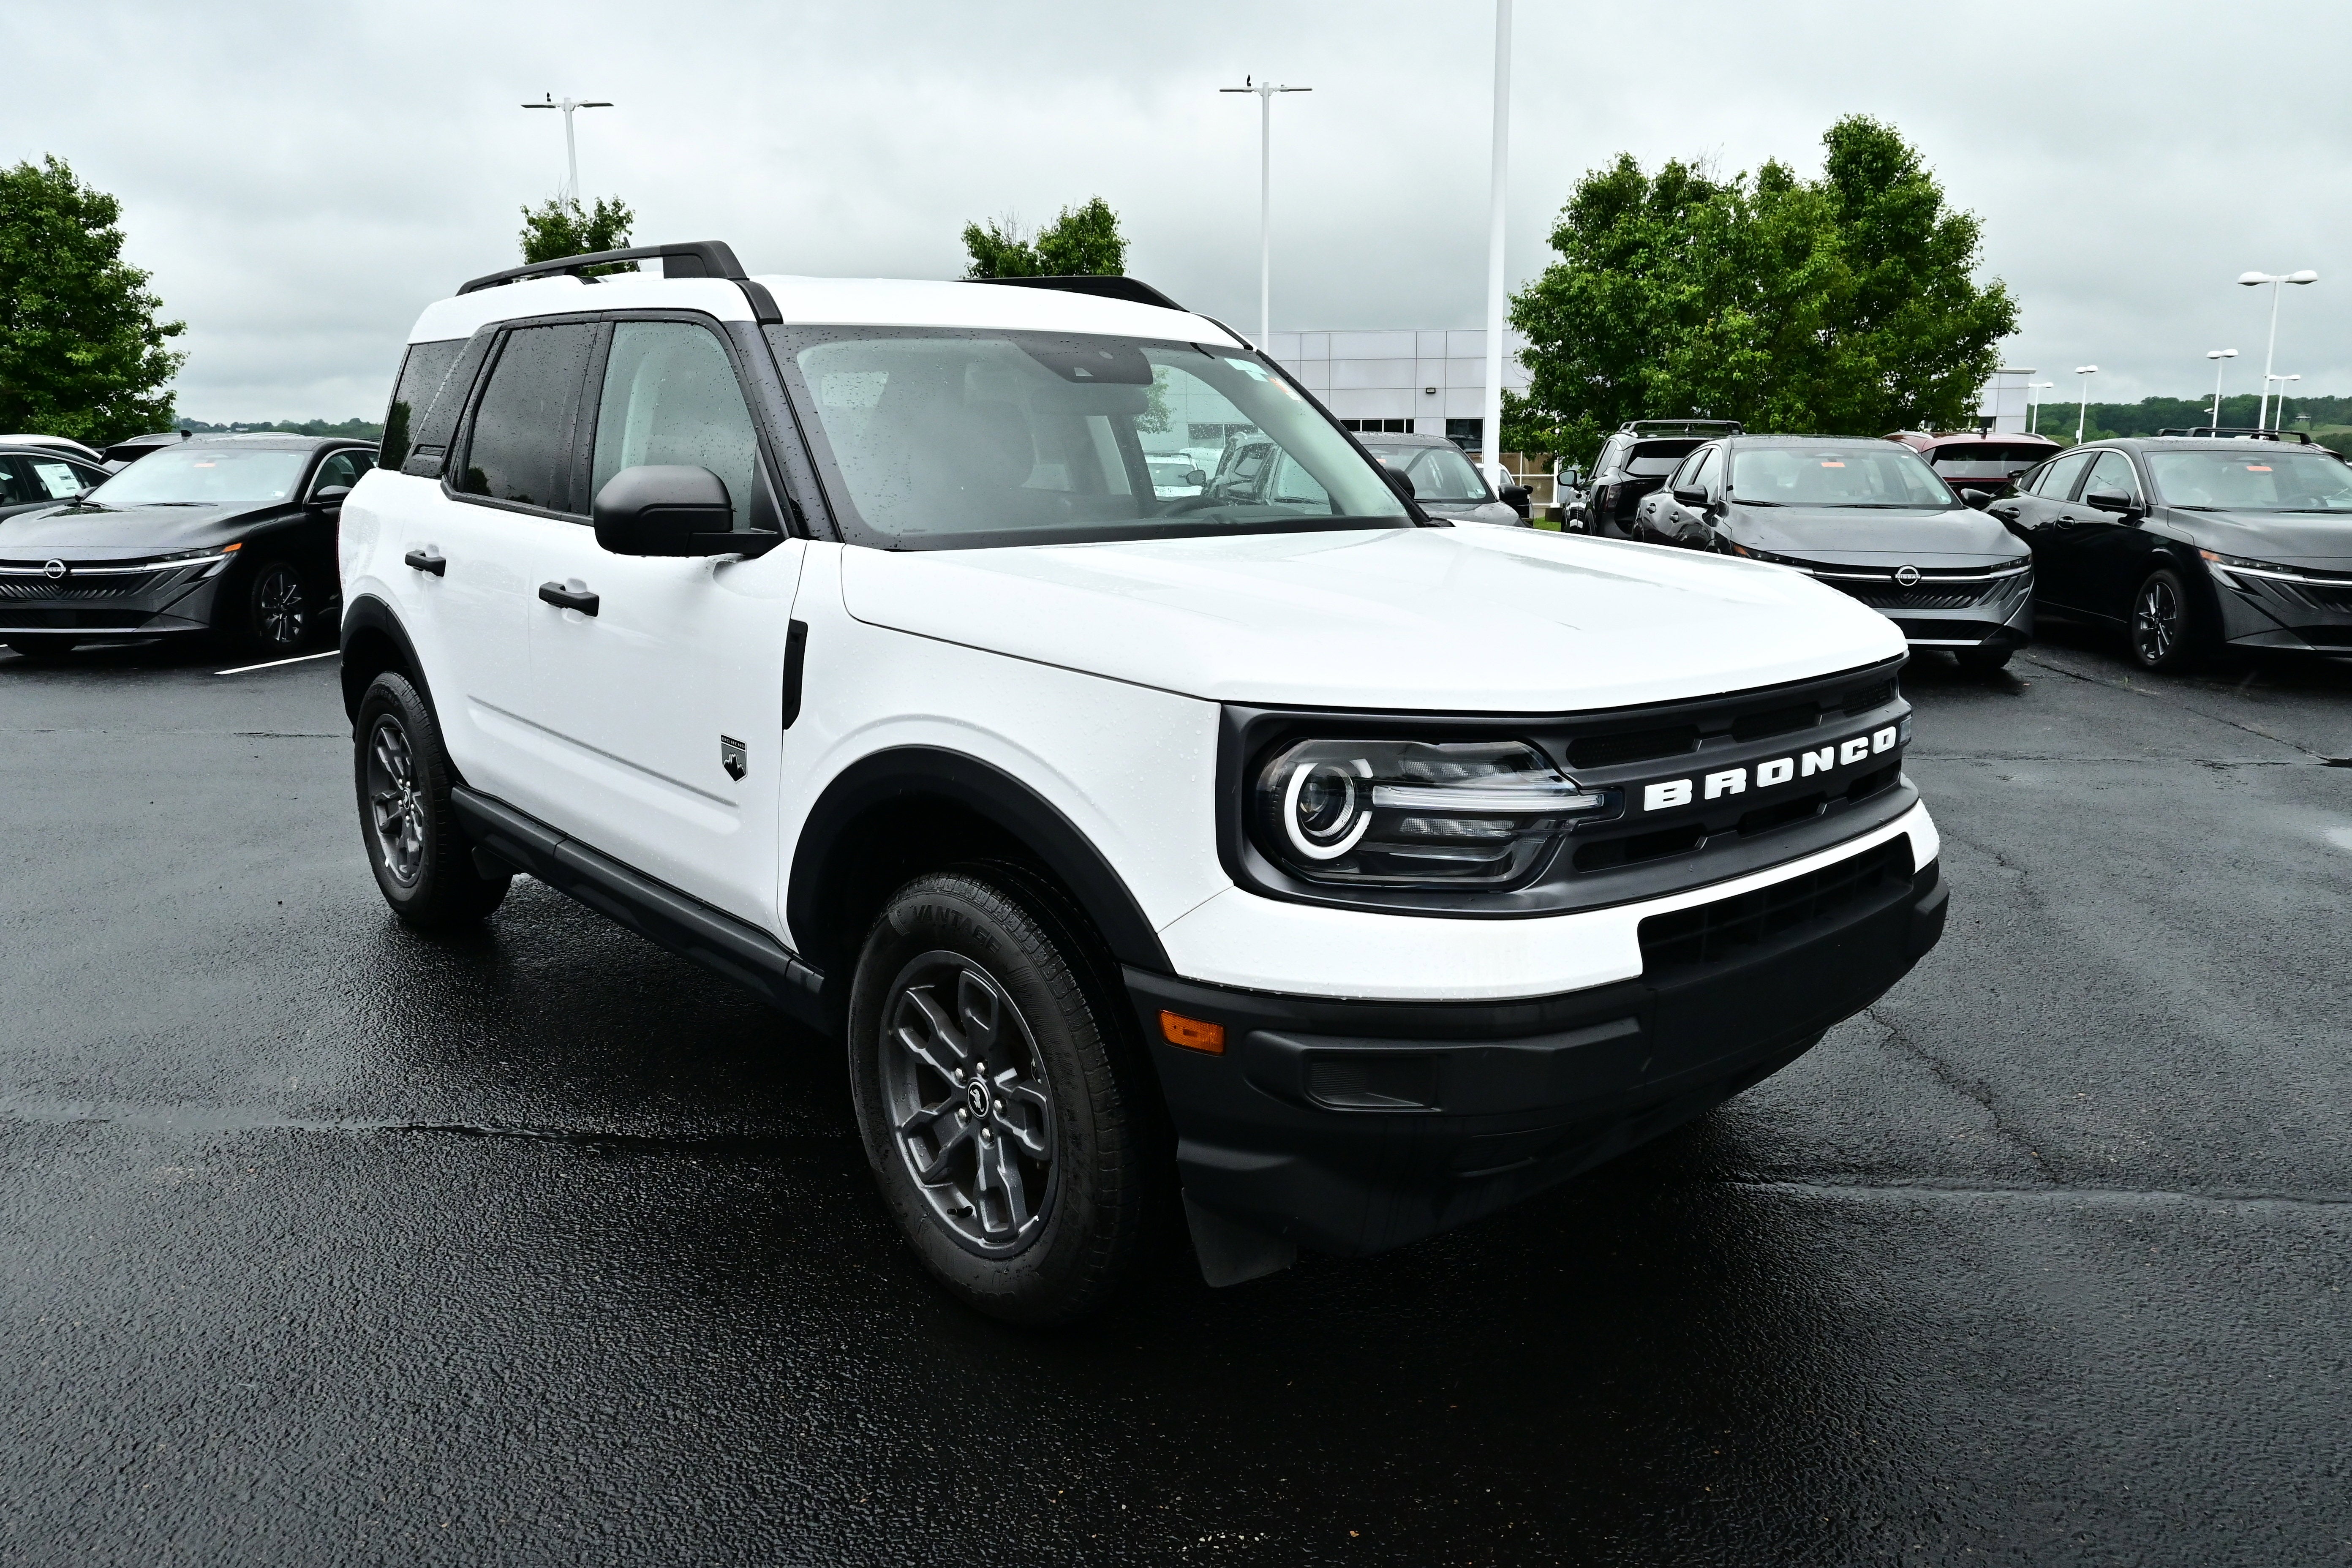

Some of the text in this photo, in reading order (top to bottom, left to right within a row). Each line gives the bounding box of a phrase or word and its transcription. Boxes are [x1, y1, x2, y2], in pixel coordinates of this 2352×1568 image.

[731, 740, 745, 749] BEND
[1644, 726, 1897, 811] BRONCO
[910, 904, 1002, 955] VANTAGE
